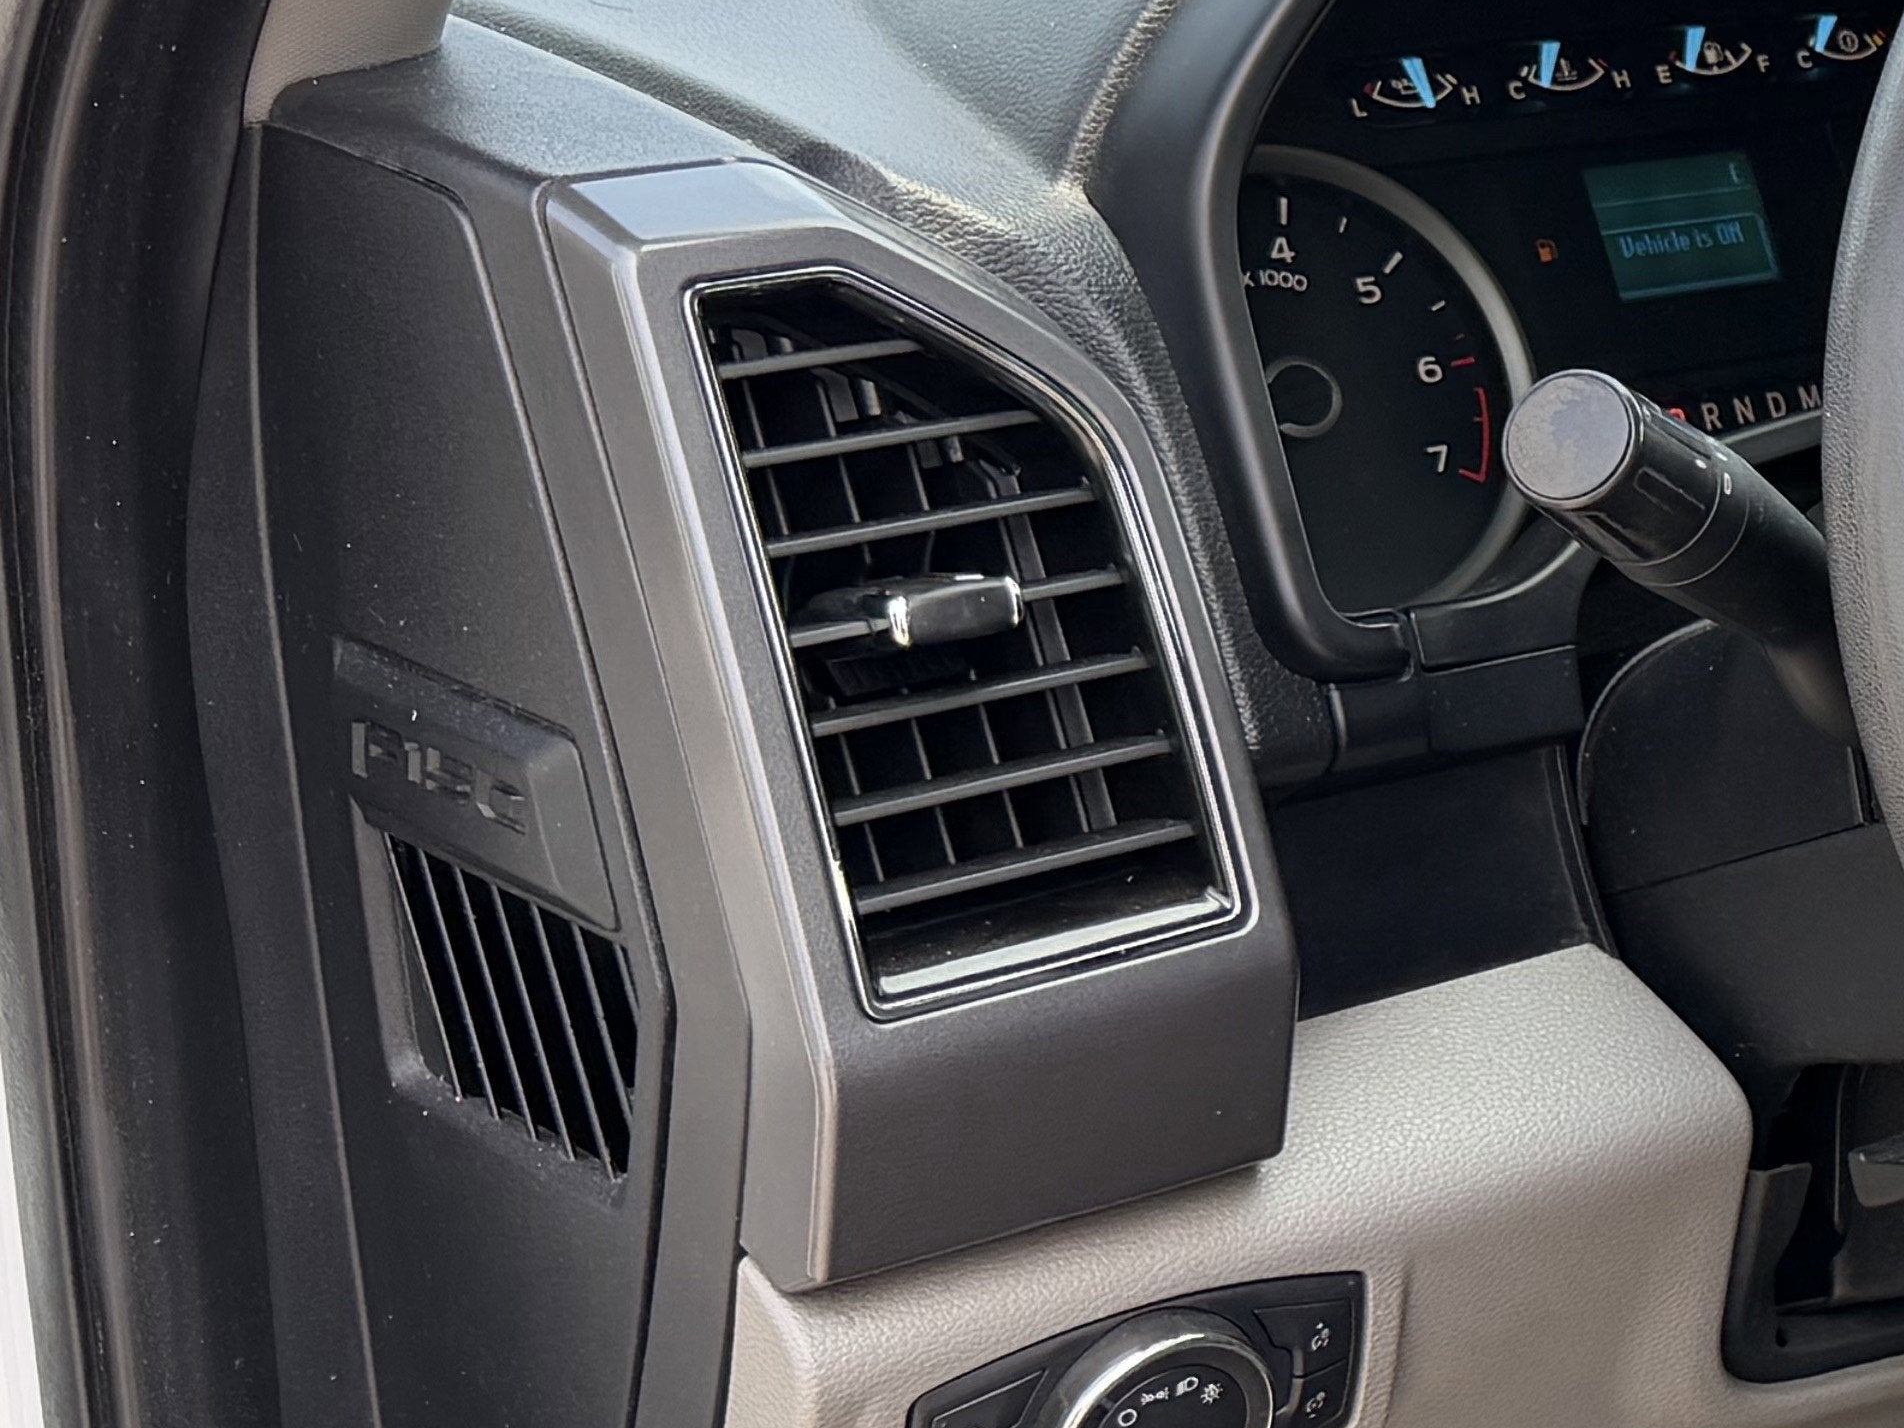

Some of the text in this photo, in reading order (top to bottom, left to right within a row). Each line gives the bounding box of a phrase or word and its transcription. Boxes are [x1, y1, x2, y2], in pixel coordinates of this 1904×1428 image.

[1655, 54, 1770, 84] E F
[1798, 49, 1813, 68] C
[1508, 69, 1632, 100] C H
[1351, 85, 1480, 118] L H
[1270, 236, 1296, 264] 4
[1619, 230, 1690, 259] Vehicle
[1695, 229, 1713, 248] is
[1259, 269, 1308, 292] 1000
[1355, 275, 1382, 304] 5
[1416, 356, 1443, 384] 6
[1700, 402, 1723, 432] R
[1732, 395, 1757, 424] N
[1765, 391, 1787, 419] D
[1798, 384, 1822, 410] M
[1426, 444, 1448, 473] 7
